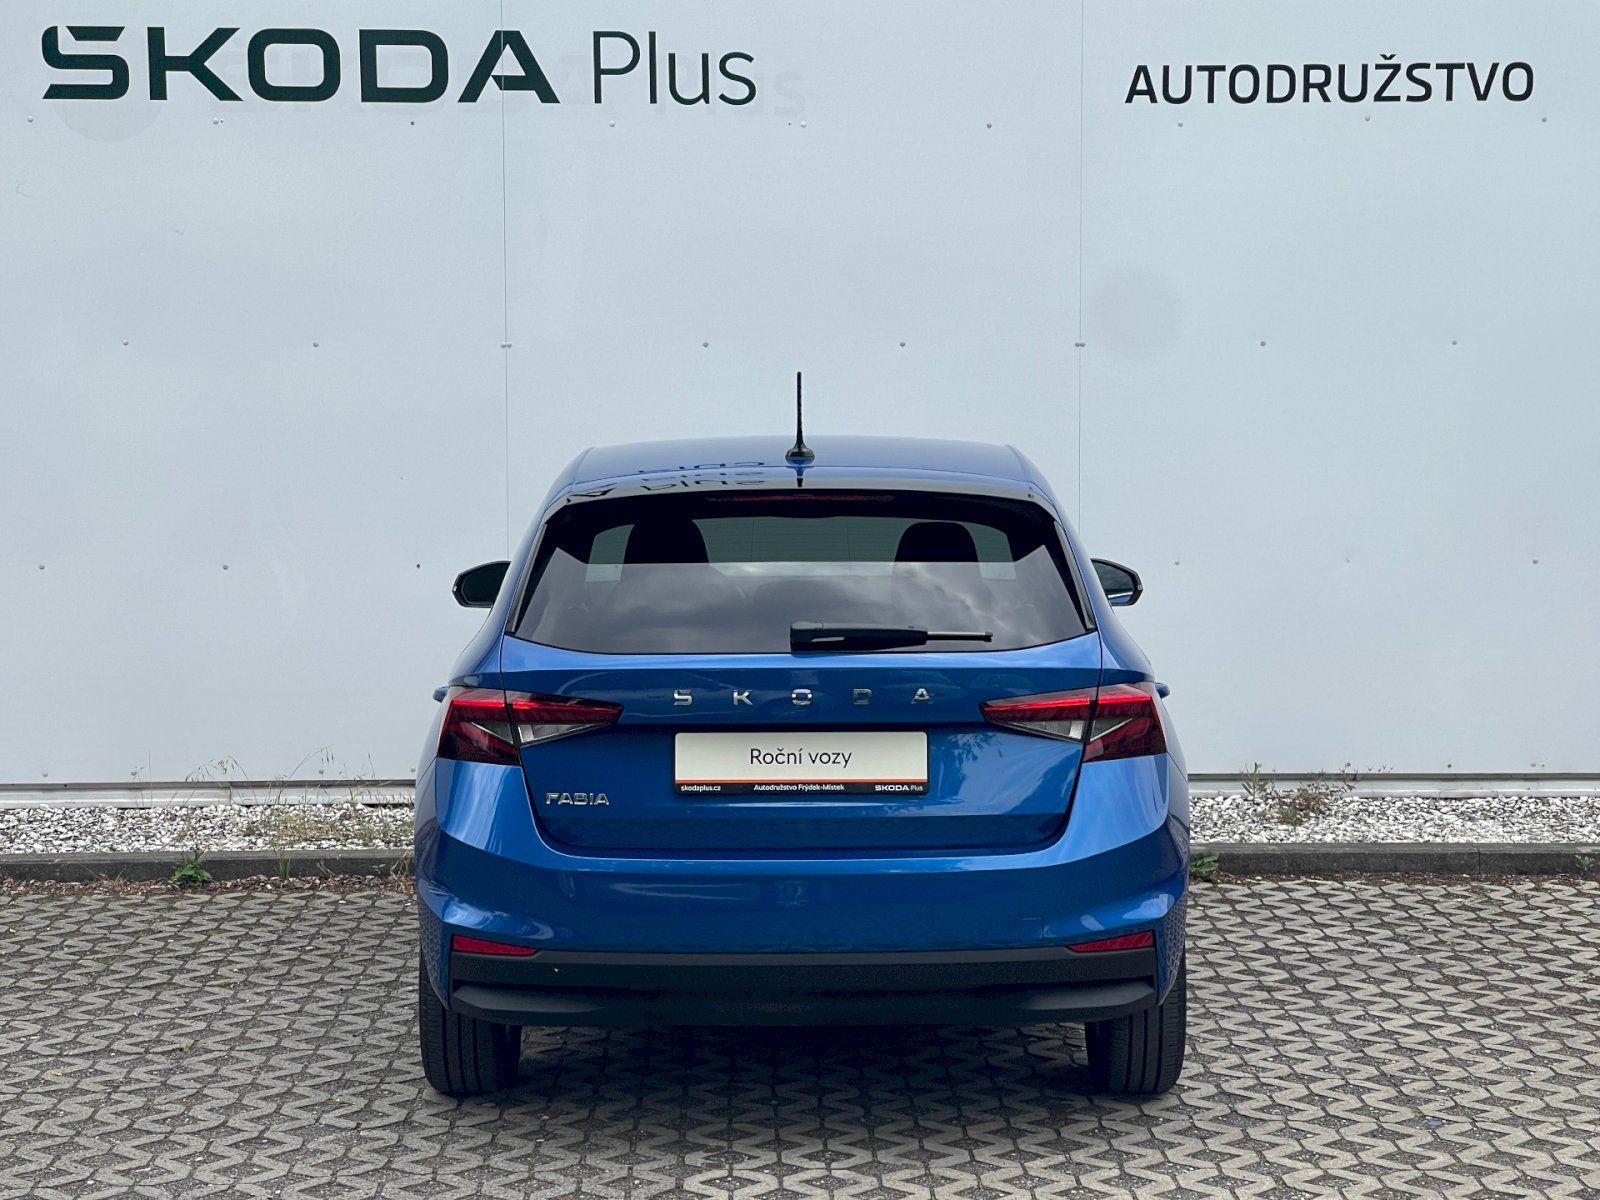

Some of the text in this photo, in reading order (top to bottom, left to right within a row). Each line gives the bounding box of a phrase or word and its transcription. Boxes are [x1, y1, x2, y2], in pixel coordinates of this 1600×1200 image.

[592, 30, 757, 106] Plus
[1124, 53, 1534, 105] AUTODRUŽSTVO
[750, 747, 852, 769] Roční vozy
[680, 784, 722, 793] skodaplus.cz
[910, 784, 924, 792] Plus
[545, 792, 610, 806] FABIA
